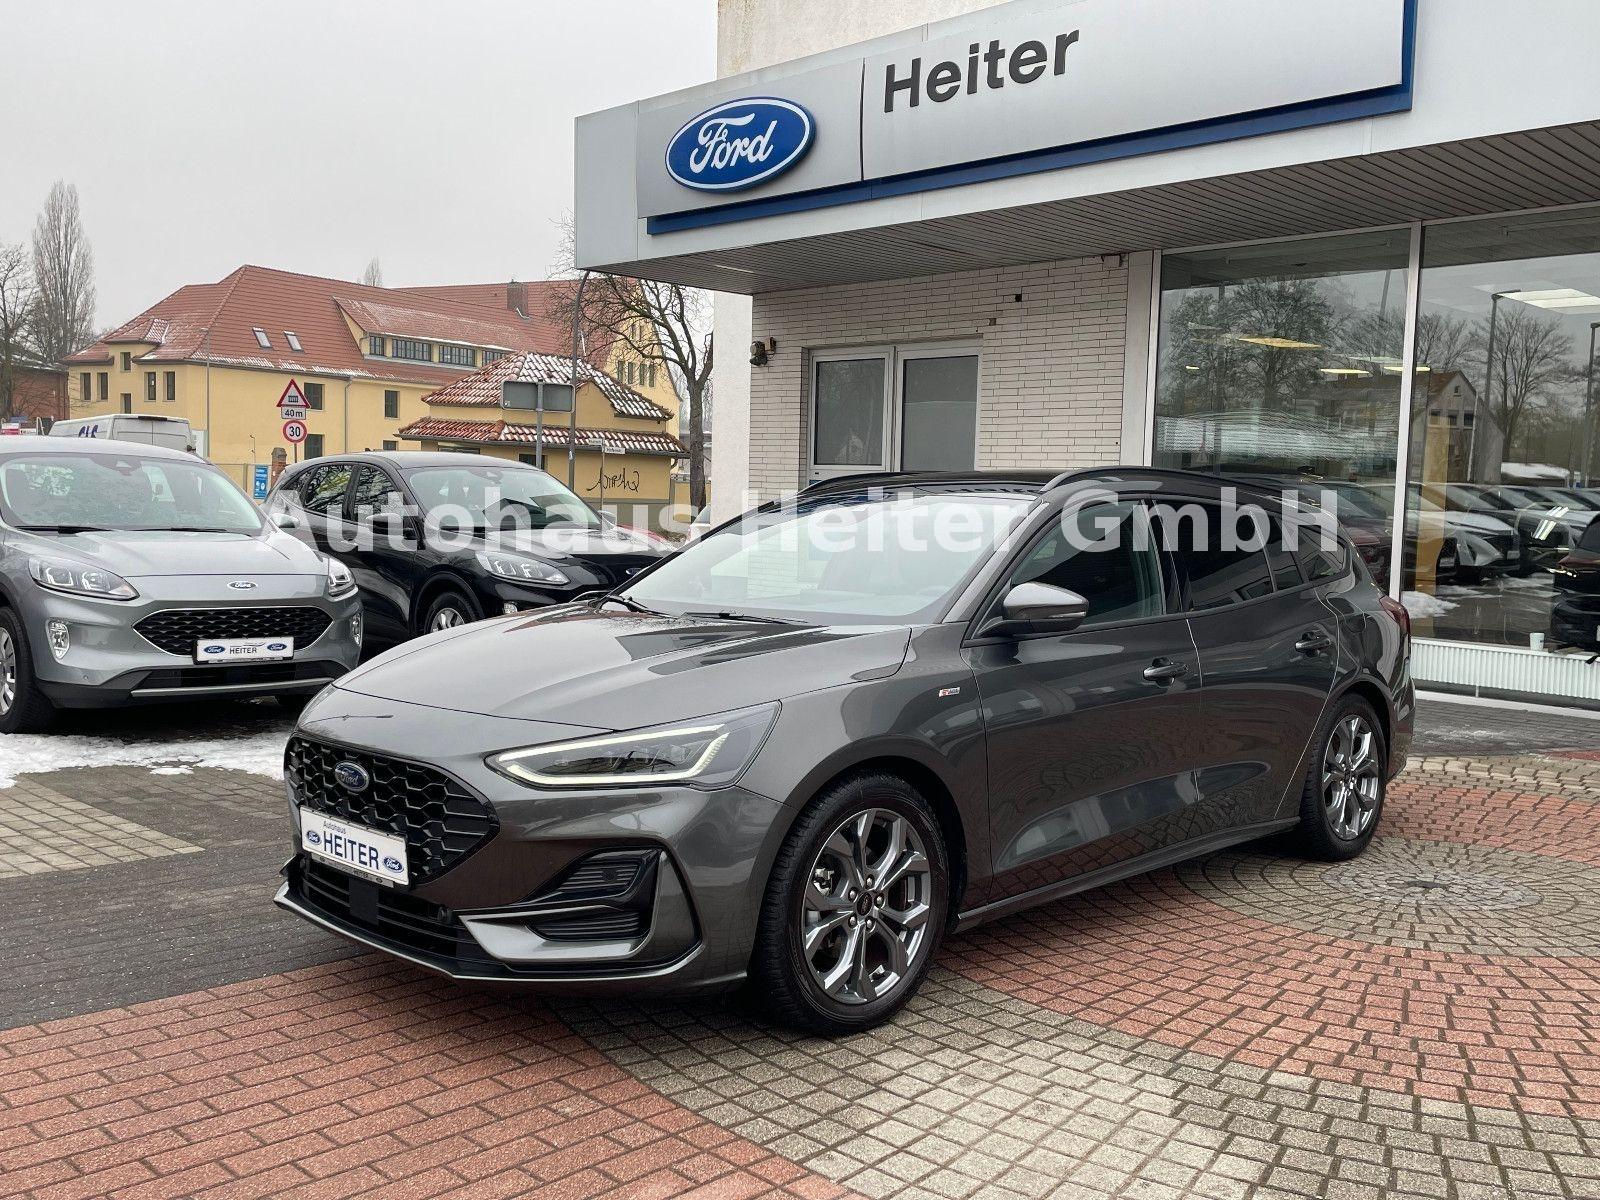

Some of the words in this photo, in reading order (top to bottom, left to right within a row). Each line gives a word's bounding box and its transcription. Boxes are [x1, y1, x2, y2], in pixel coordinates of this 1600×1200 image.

[883, 29, 1080, 114] Heiter
[689, 112, 778, 174] Ford
[289, 426, 301, 437] 30
[323, 831, 379, 870] HEITER
